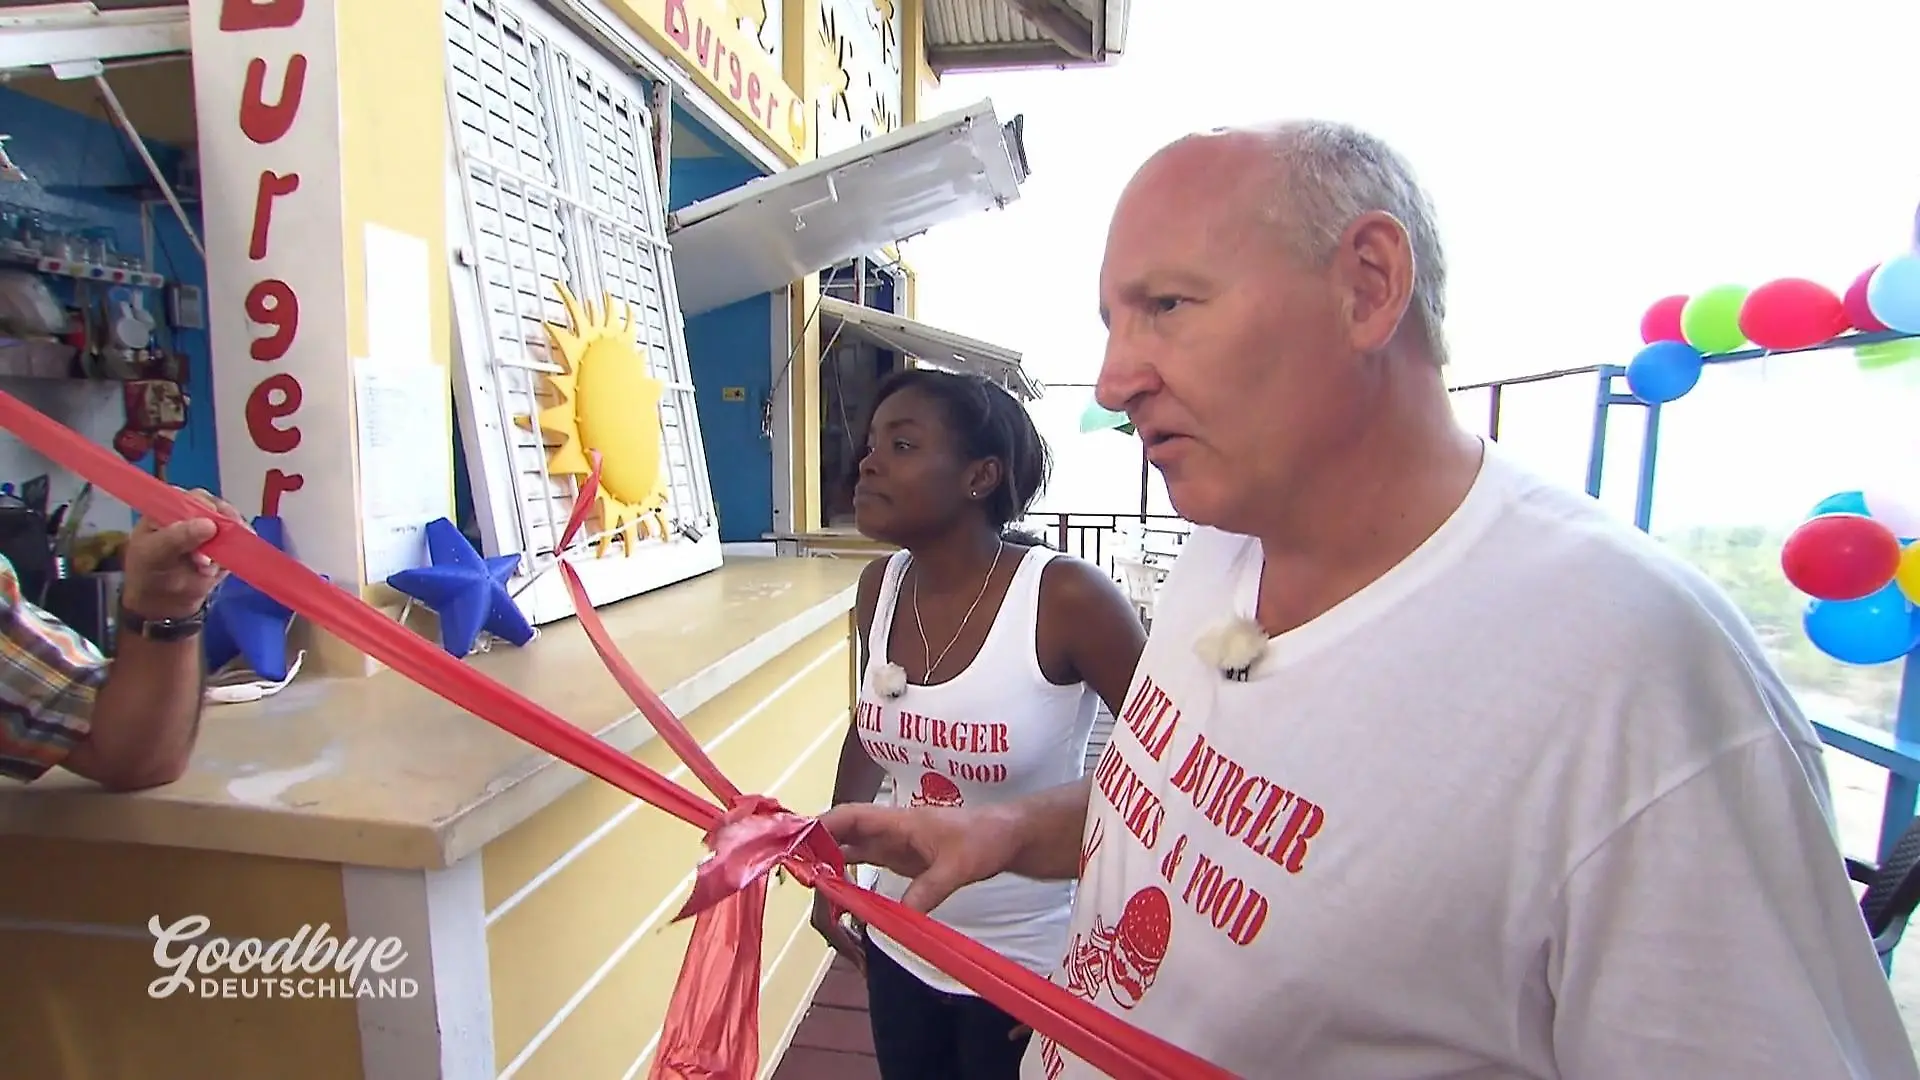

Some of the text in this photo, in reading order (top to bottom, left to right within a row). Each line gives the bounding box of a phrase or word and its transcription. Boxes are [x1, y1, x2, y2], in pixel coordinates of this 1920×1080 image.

[218, 0, 308, 517] urger
[858, 700, 1010, 754] ELI BURGER
[862, 739, 1008, 783] INKS & FOOD
[1122, 674, 1325, 874] DELI BURGER
[1095, 740, 1269, 946] DRINKS & FOOD
